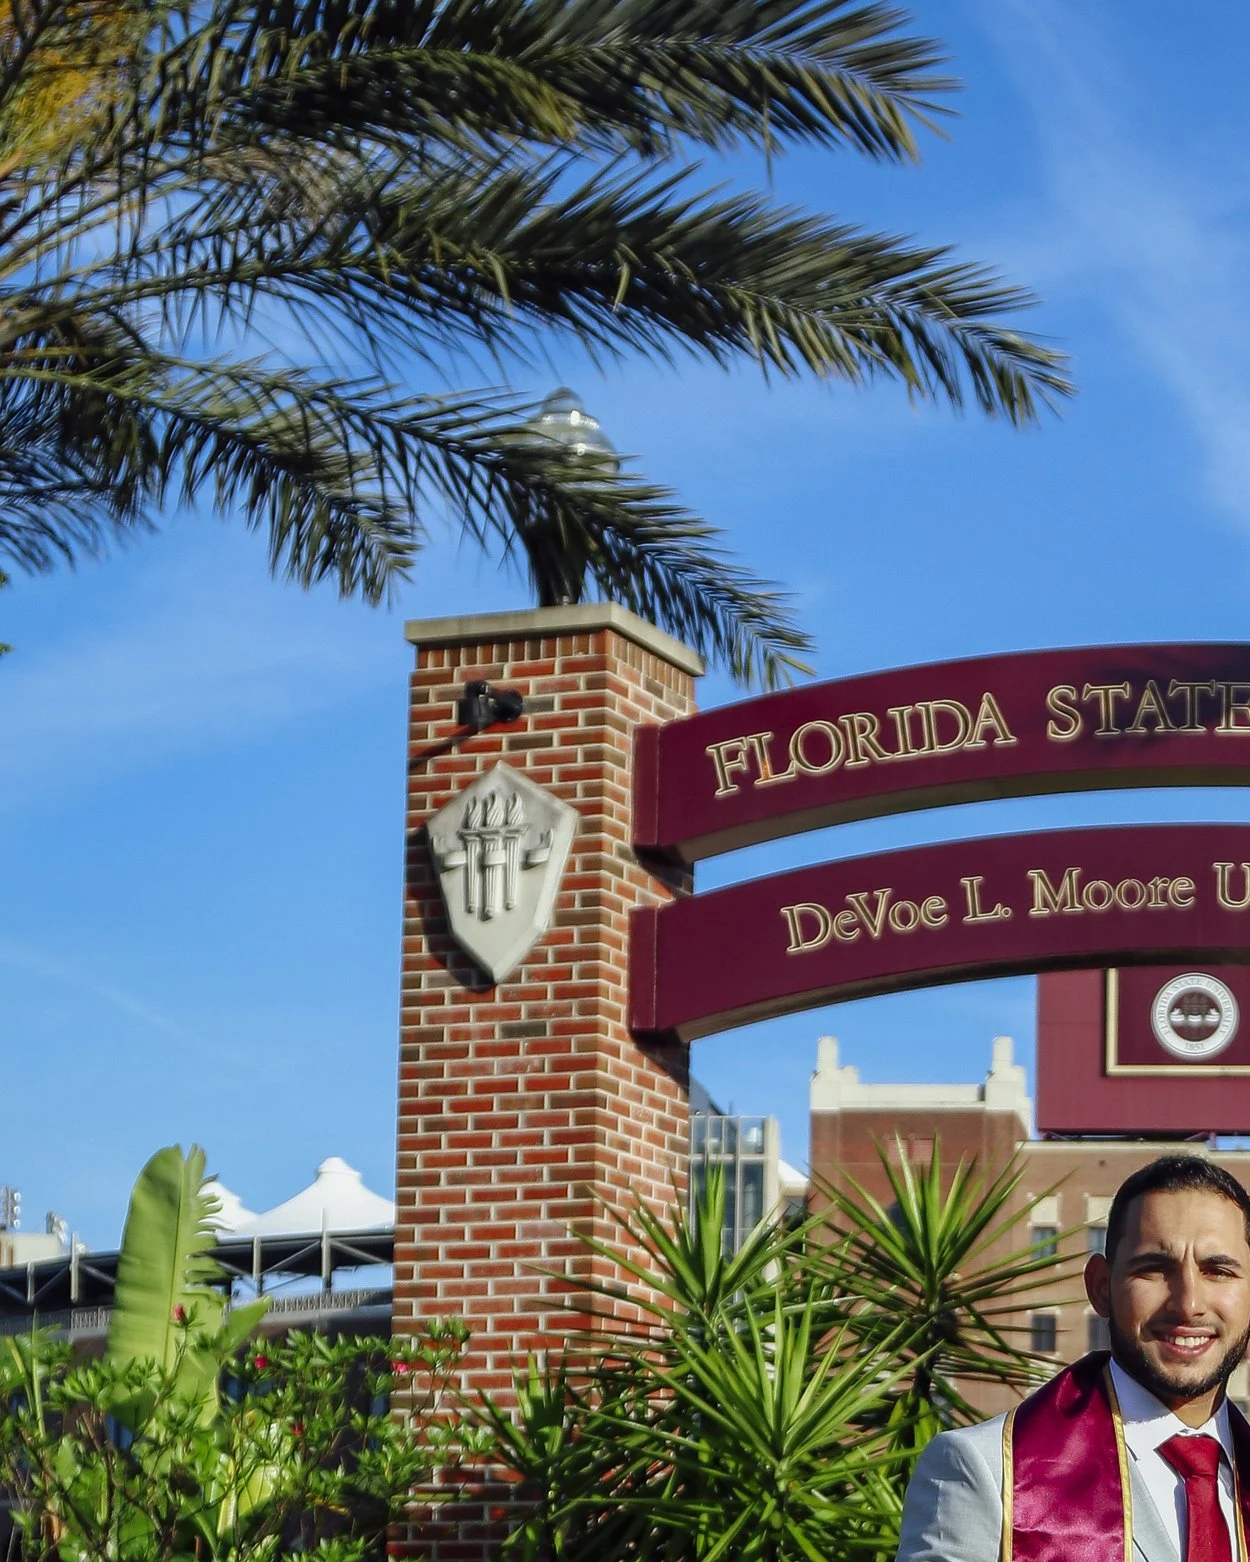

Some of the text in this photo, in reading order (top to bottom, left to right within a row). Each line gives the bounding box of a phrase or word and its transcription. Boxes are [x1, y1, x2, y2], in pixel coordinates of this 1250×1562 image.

[706, 692, 1017, 797] FLORIDA
[781, 888, 948, 954] DeVoe
[961, 876, 1012, 924] L.
[1028, 867, 1195, 916] Moore
